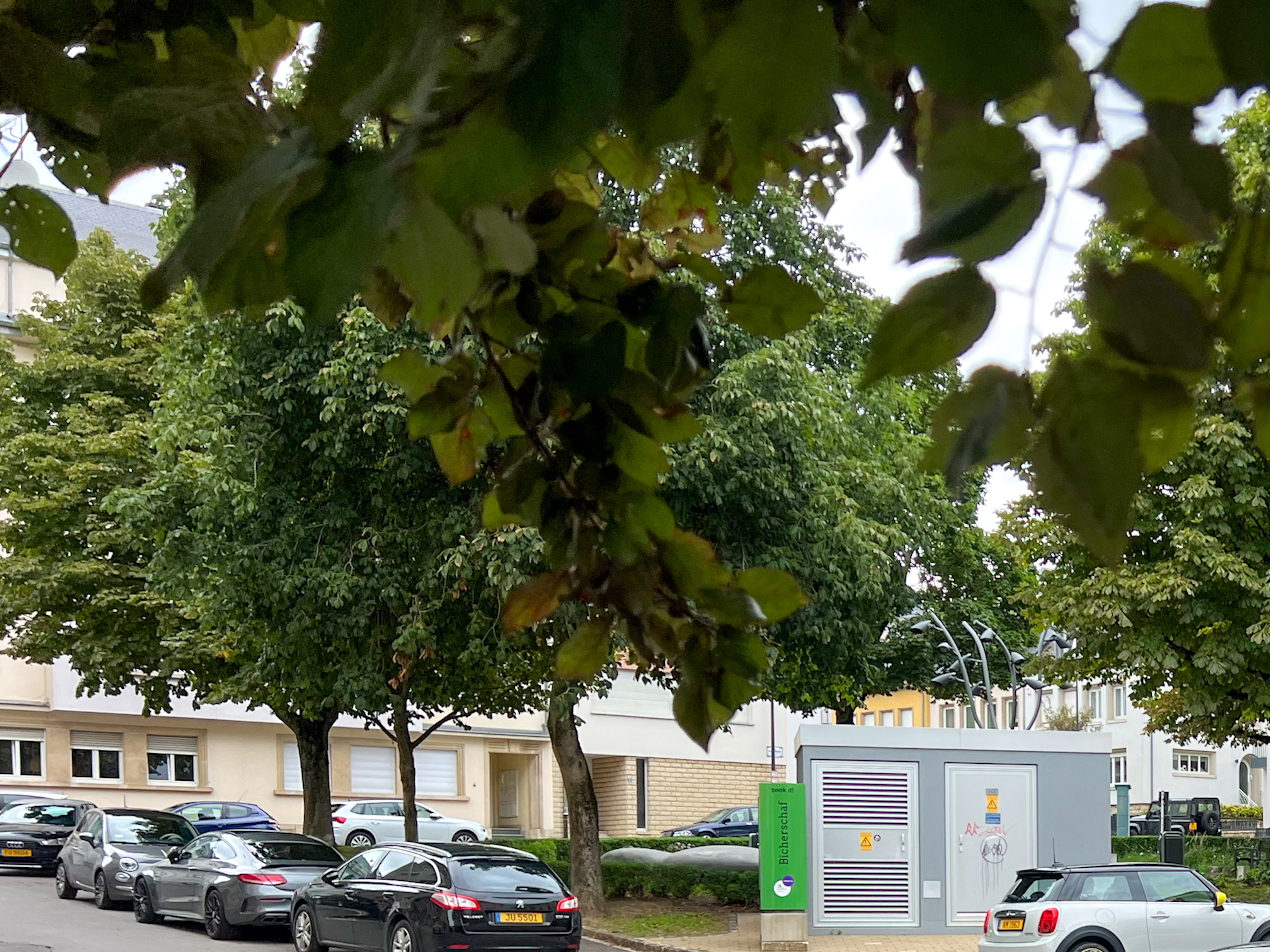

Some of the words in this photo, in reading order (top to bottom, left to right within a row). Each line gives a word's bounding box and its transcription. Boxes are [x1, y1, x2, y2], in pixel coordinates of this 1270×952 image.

[778, 801, 789, 866] Bicherschaf
[505, 913, 516, 921] JU
[517, 913, 538, 921] 5501
